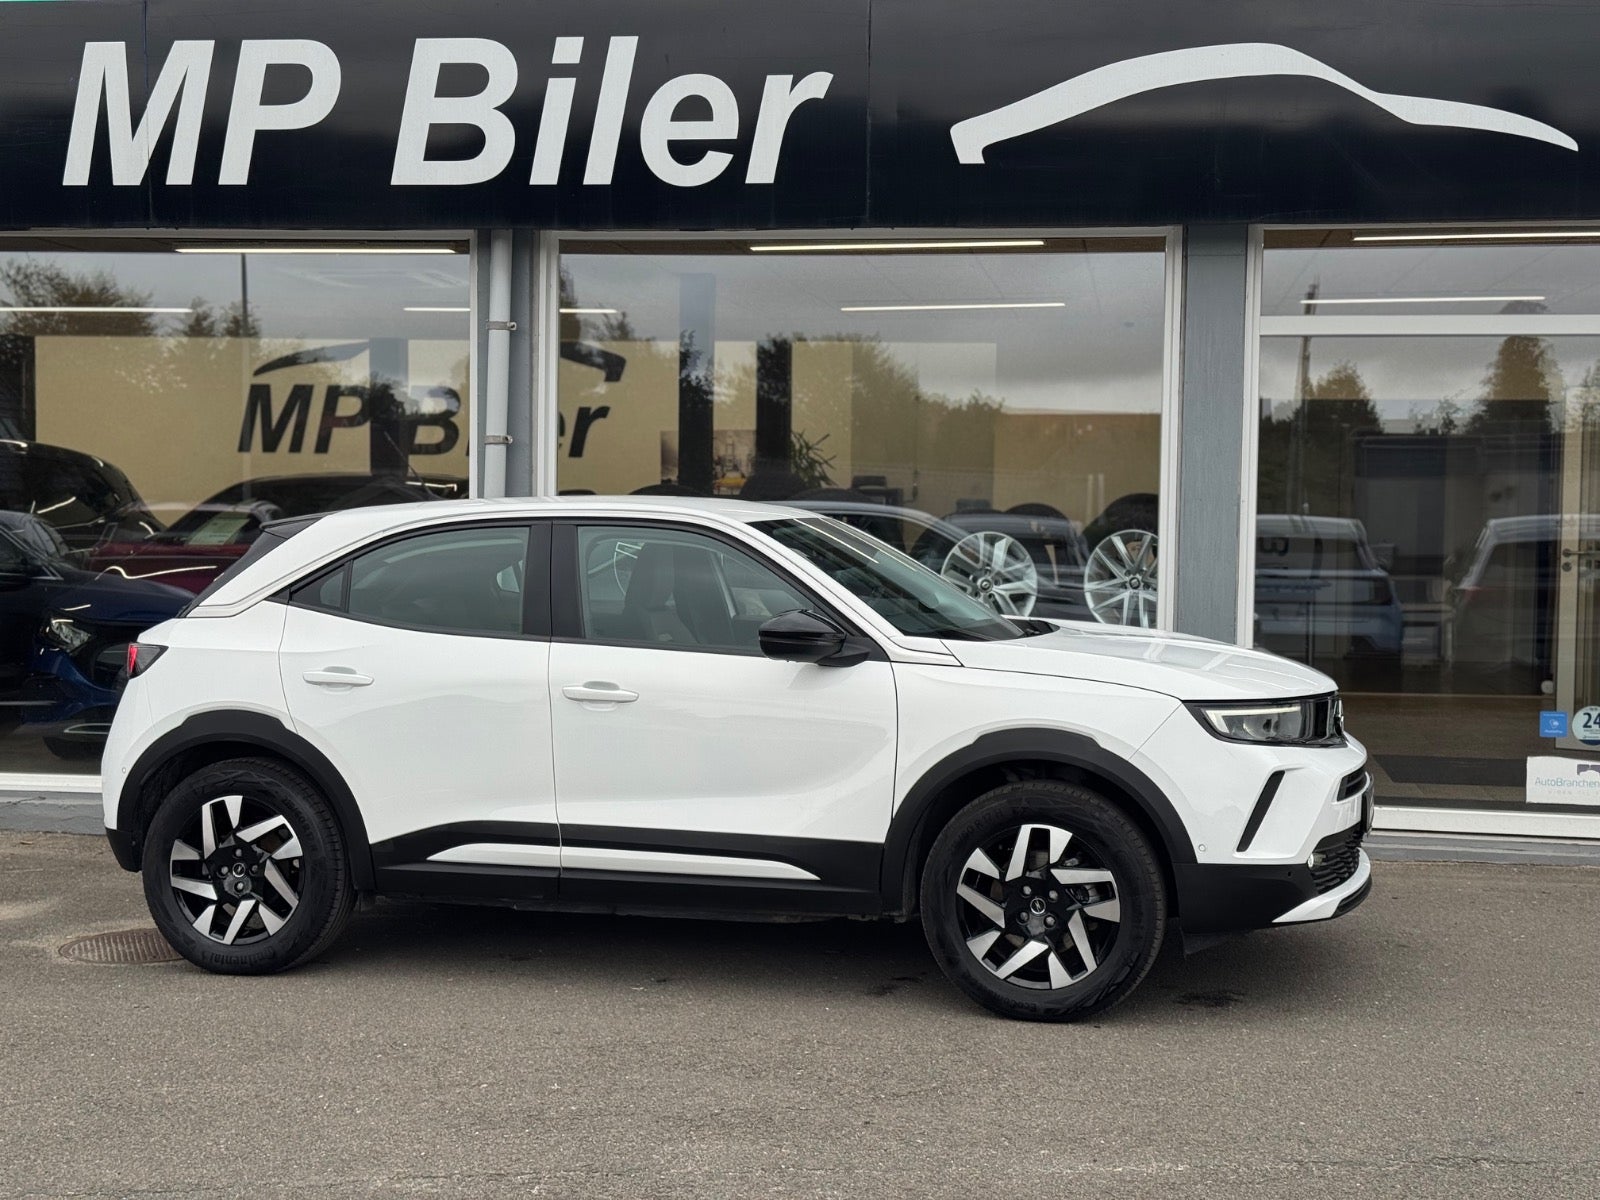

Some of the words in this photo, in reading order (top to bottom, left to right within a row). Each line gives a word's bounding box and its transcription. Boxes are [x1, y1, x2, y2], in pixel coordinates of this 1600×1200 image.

[62, 39, 342, 187] MP
[390, 35, 835, 187] Biler
[237, 383, 371, 454] MP
